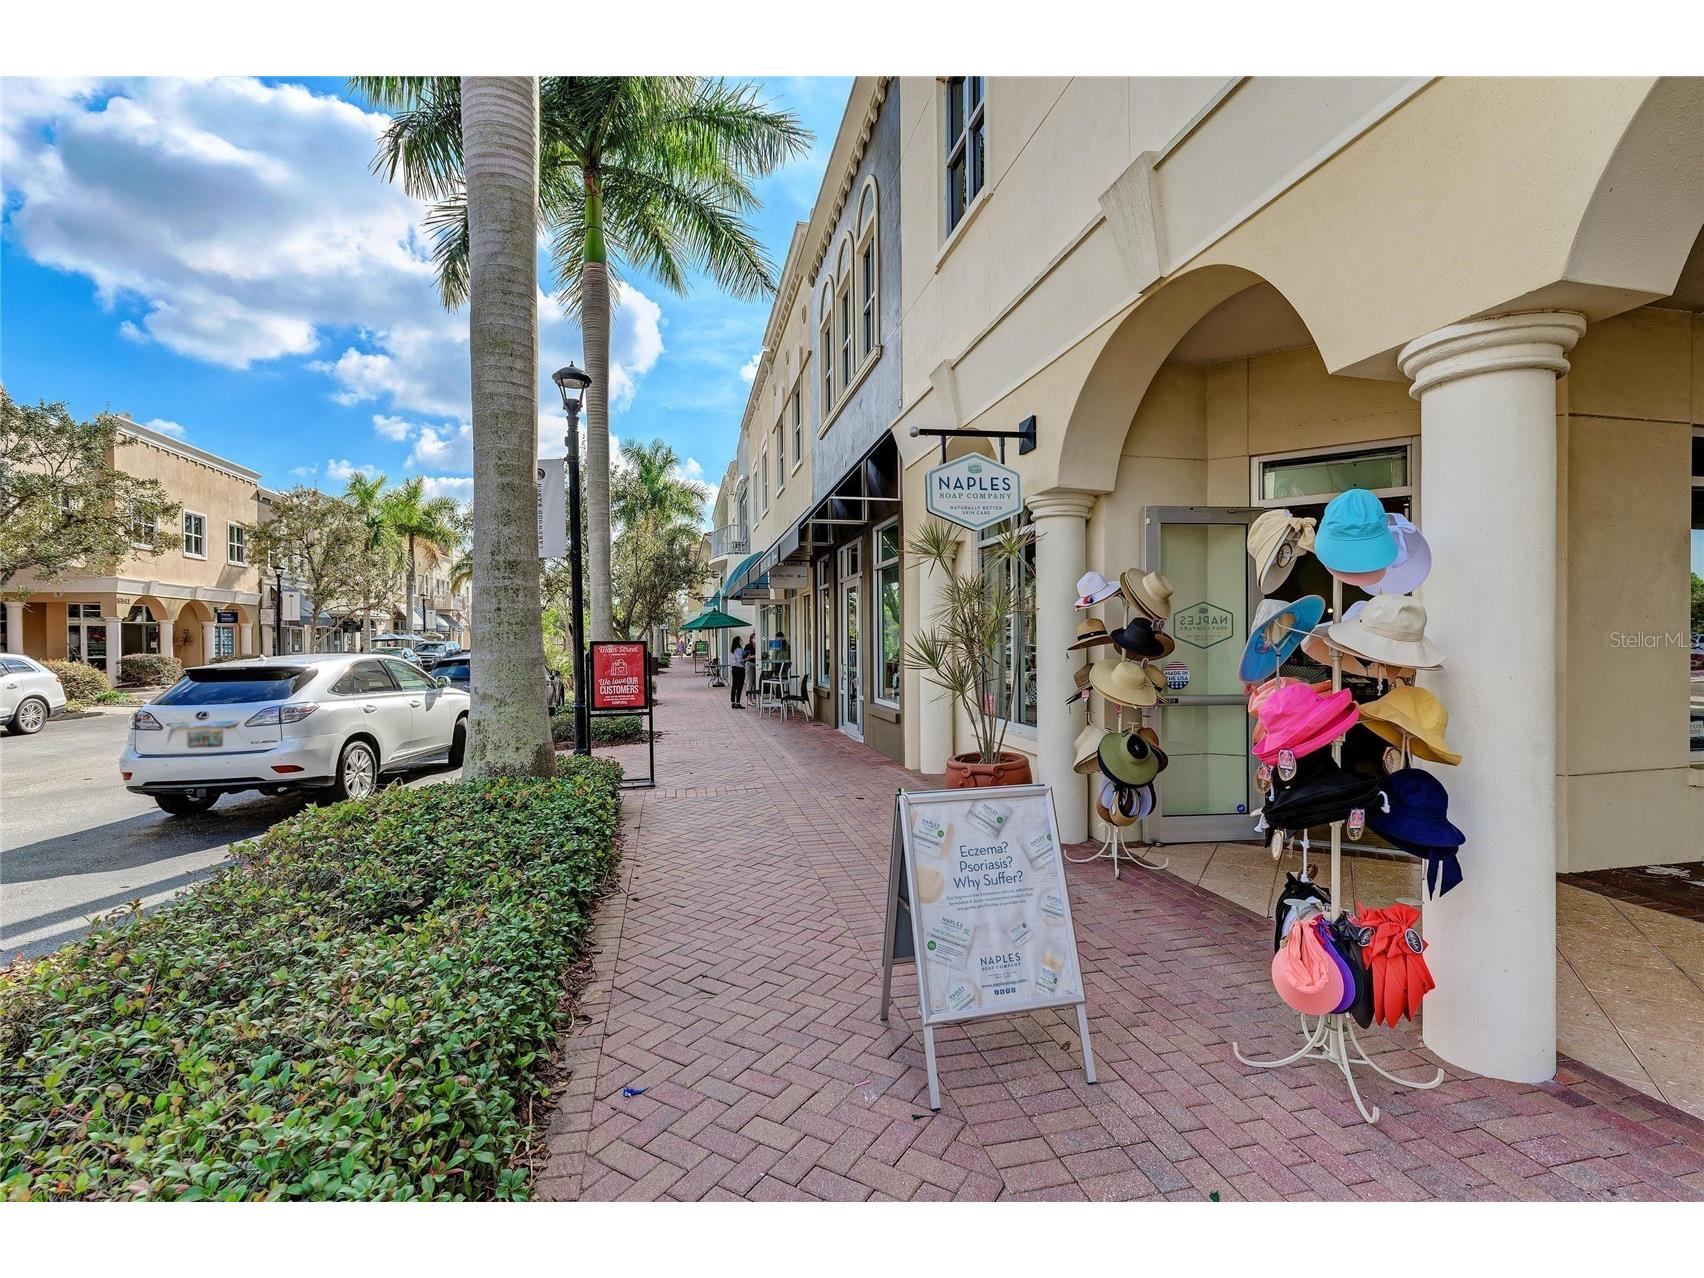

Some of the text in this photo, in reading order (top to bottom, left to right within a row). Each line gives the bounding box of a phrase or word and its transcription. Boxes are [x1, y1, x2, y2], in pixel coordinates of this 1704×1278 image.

[938, 476, 1011, 491] NAPLES
[966, 492, 1012, 500] COMPANY
[618, 645, 639, 653] Street
[626, 676, 639, 685] OUR
[599, 684, 640, 695] CUSTOMERS
[959, 841, 1009, 857] Eczema?
[959, 856, 1013, 872] Psoriasis?
[953, 870, 1024, 891] Why Suffer?
[979, 952, 1022, 966] NAPLES
[995, 962, 1022, 971] COMPANY
